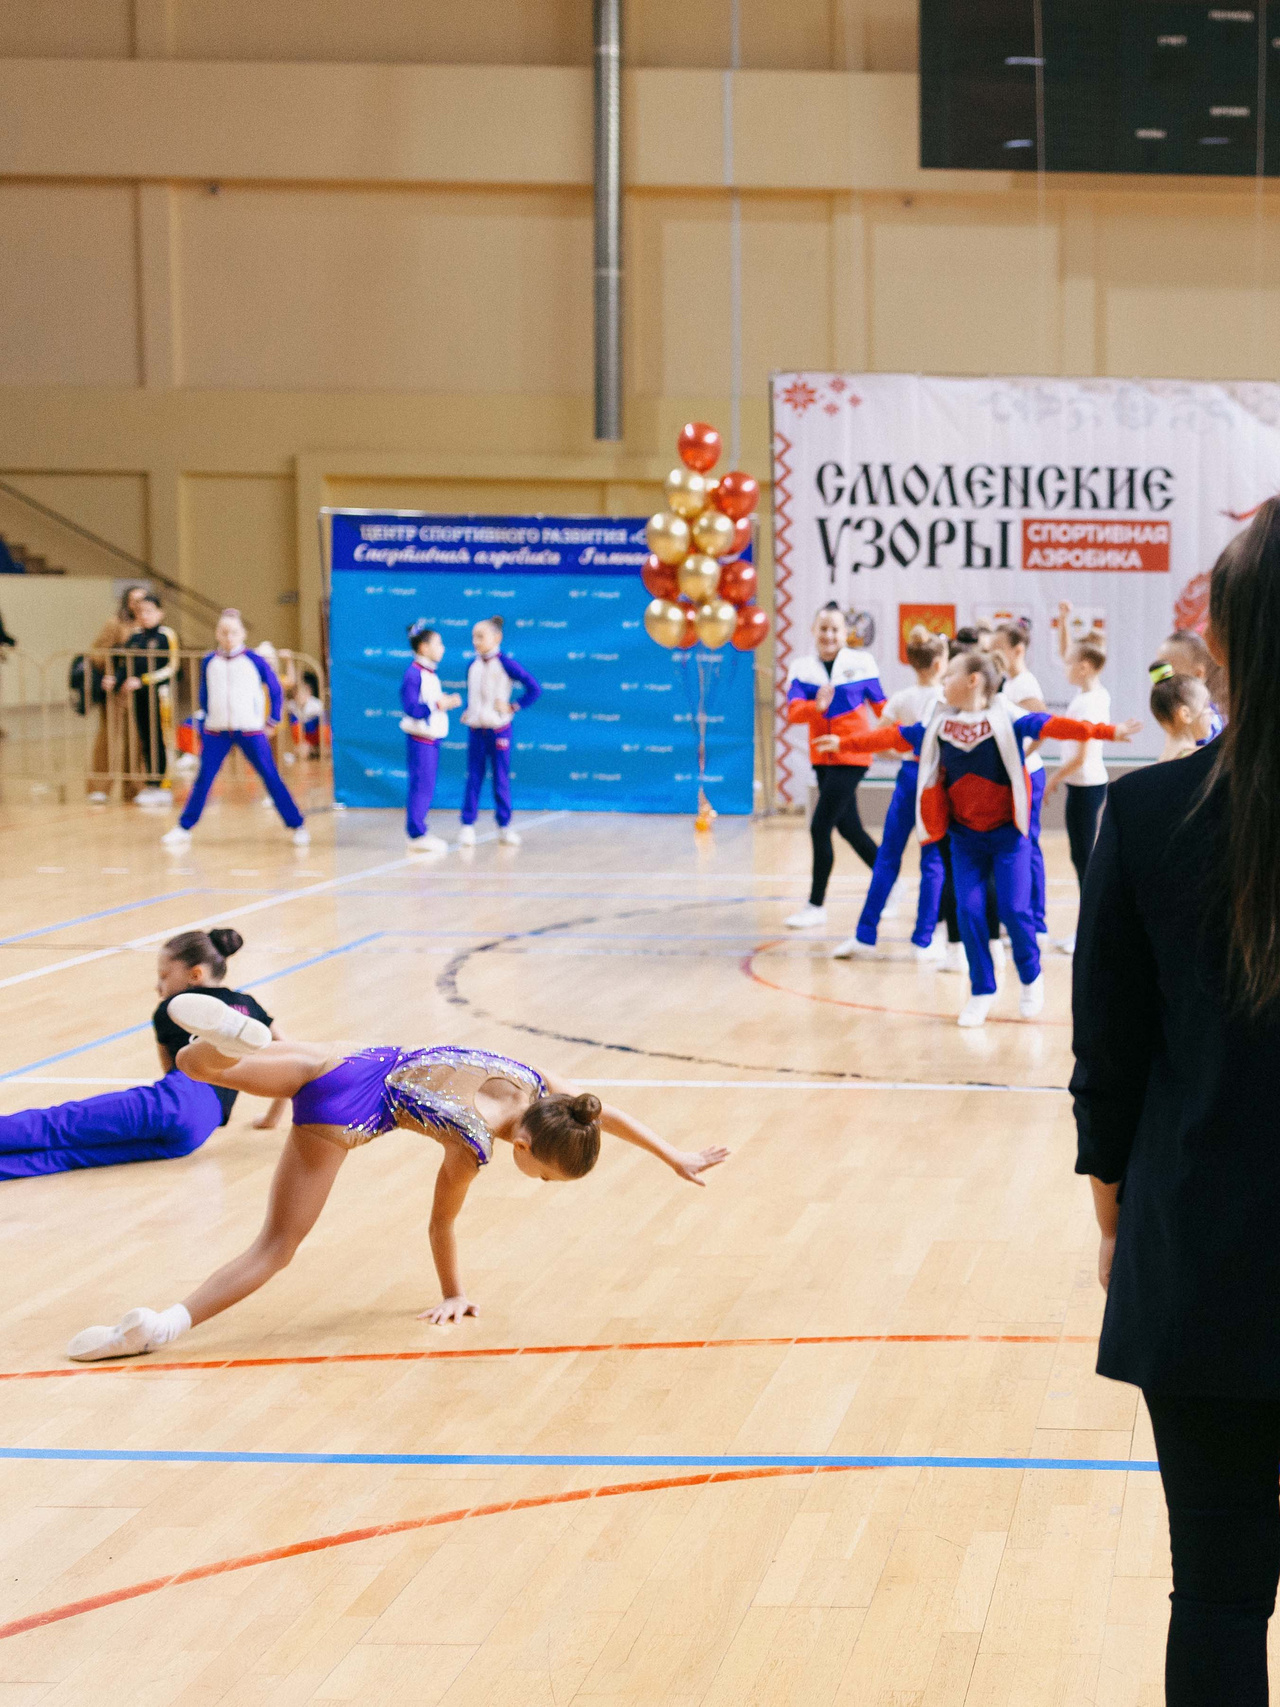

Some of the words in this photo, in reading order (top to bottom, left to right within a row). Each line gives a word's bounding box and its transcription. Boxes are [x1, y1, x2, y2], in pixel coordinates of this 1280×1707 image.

[815, 460, 1174, 512] СМОЛЕНСКИЕ
[816, 517, 1013, 583] УЗОРЫ
[1027, 523, 1169, 545] СПОРТИВНАЯ
[1027, 548, 1143, 569] АЭРОБИКА
